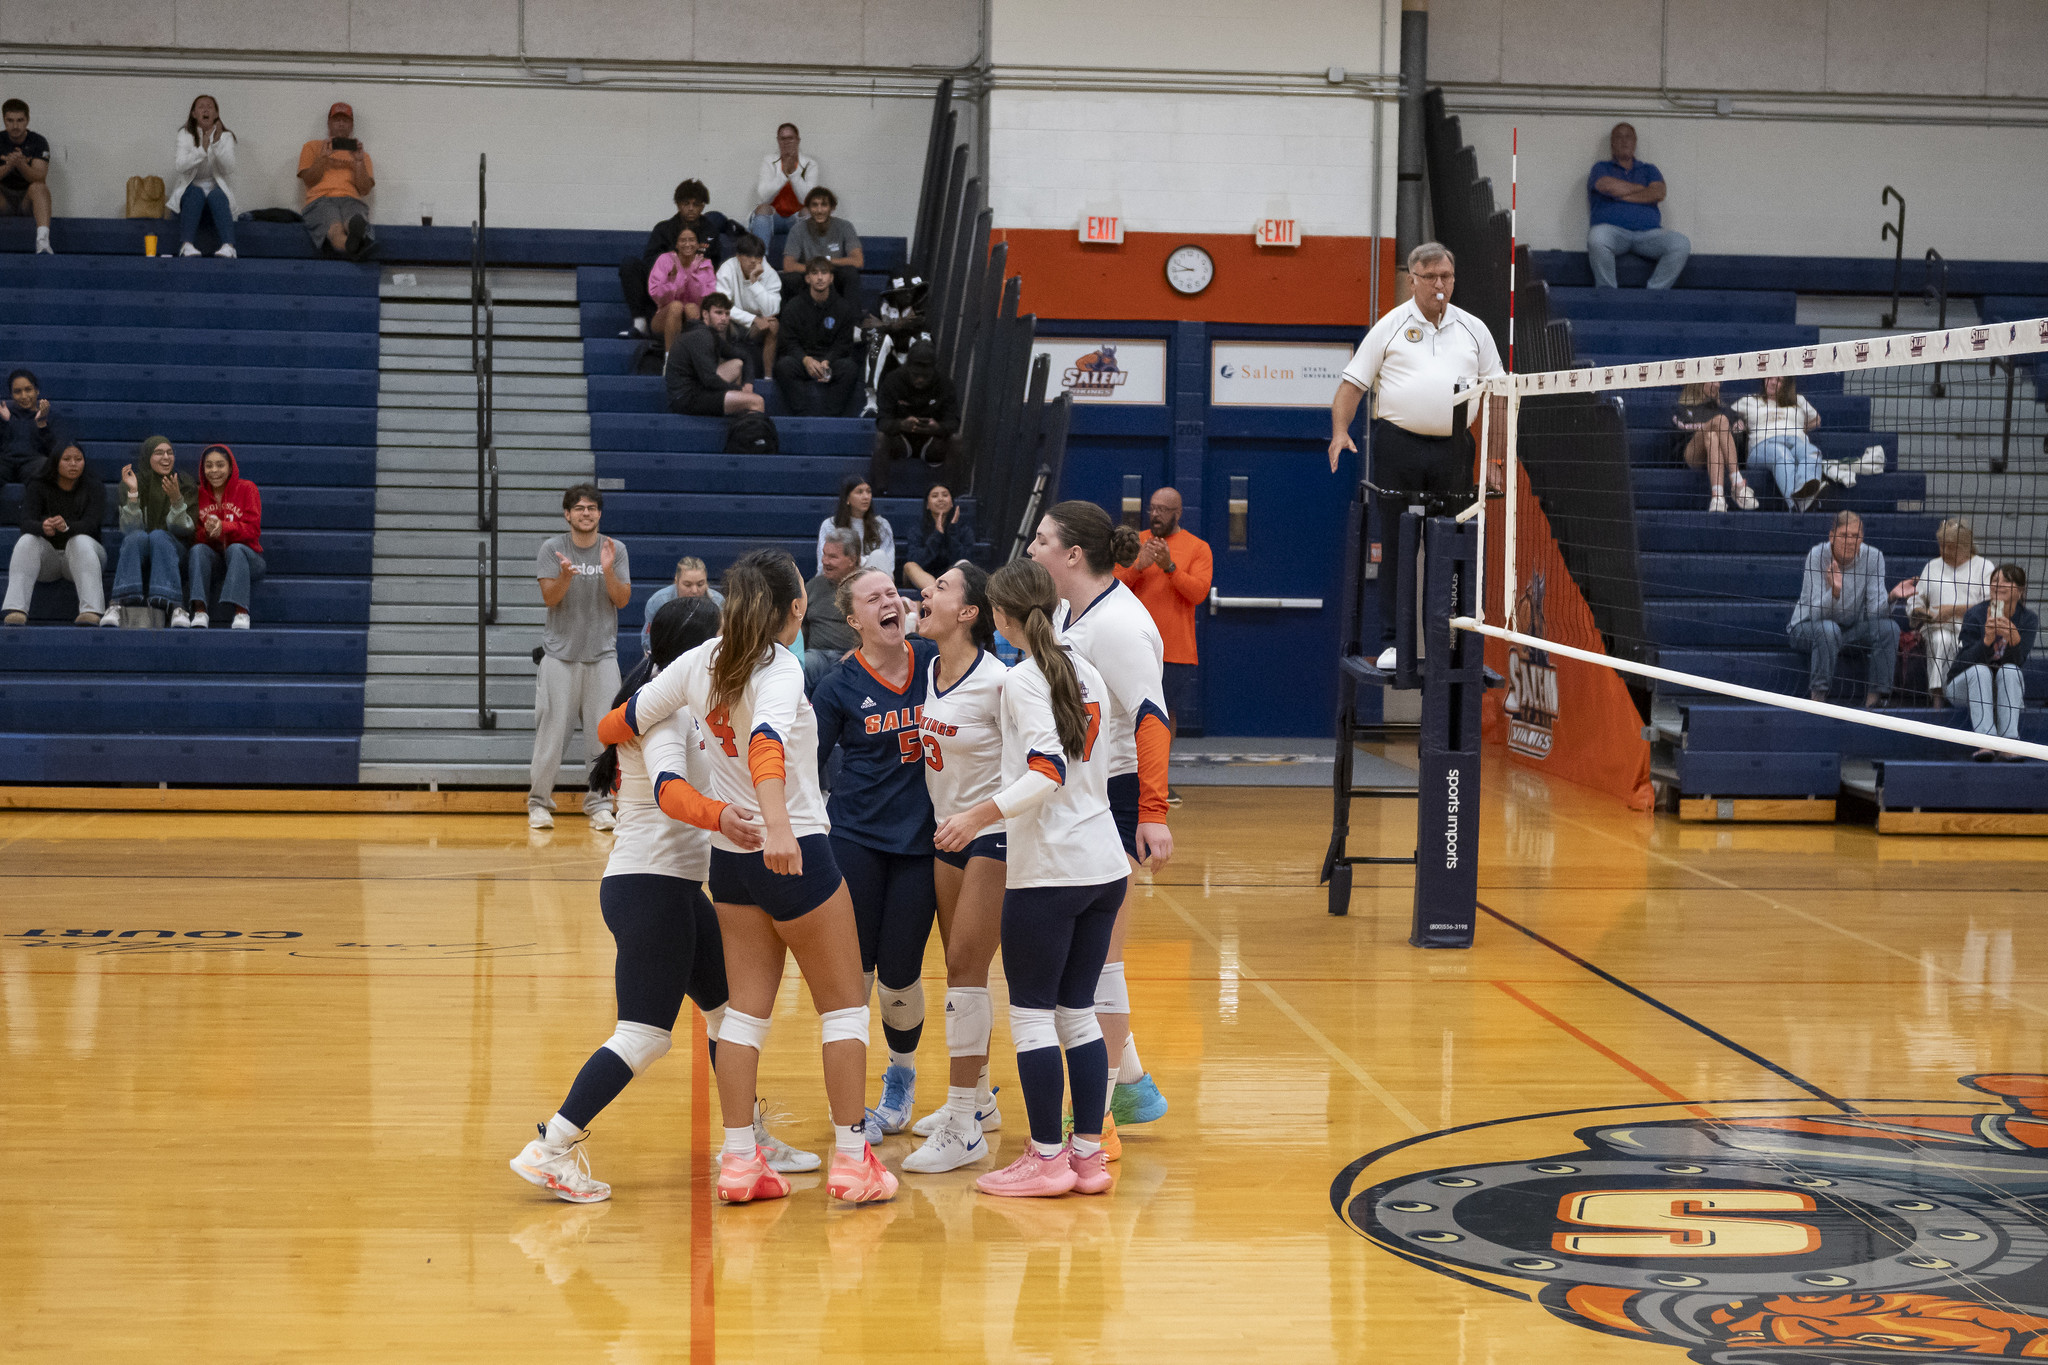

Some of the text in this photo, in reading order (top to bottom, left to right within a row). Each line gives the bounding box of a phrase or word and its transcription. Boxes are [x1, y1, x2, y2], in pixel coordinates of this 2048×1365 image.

[1087, 216, 1119, 241] EXIT
[1265, 219, 1296, 243] EXIT
[1062, 367, 1128, 387] SALEM
[1241, 364, 1295, 380] Salem
[705, 701, 739, 758] 4
[864, 702, 925, 735] SALE
[919, 715, 960, 737] KINGS
[898, 729, 924, 764] 5
[922, 734, 945, 773] 3
[1444, 769, 1460, 869] sports imports
[3, 929, 304, 939] COURT
[1551, 1188, 1823, 1258] S
